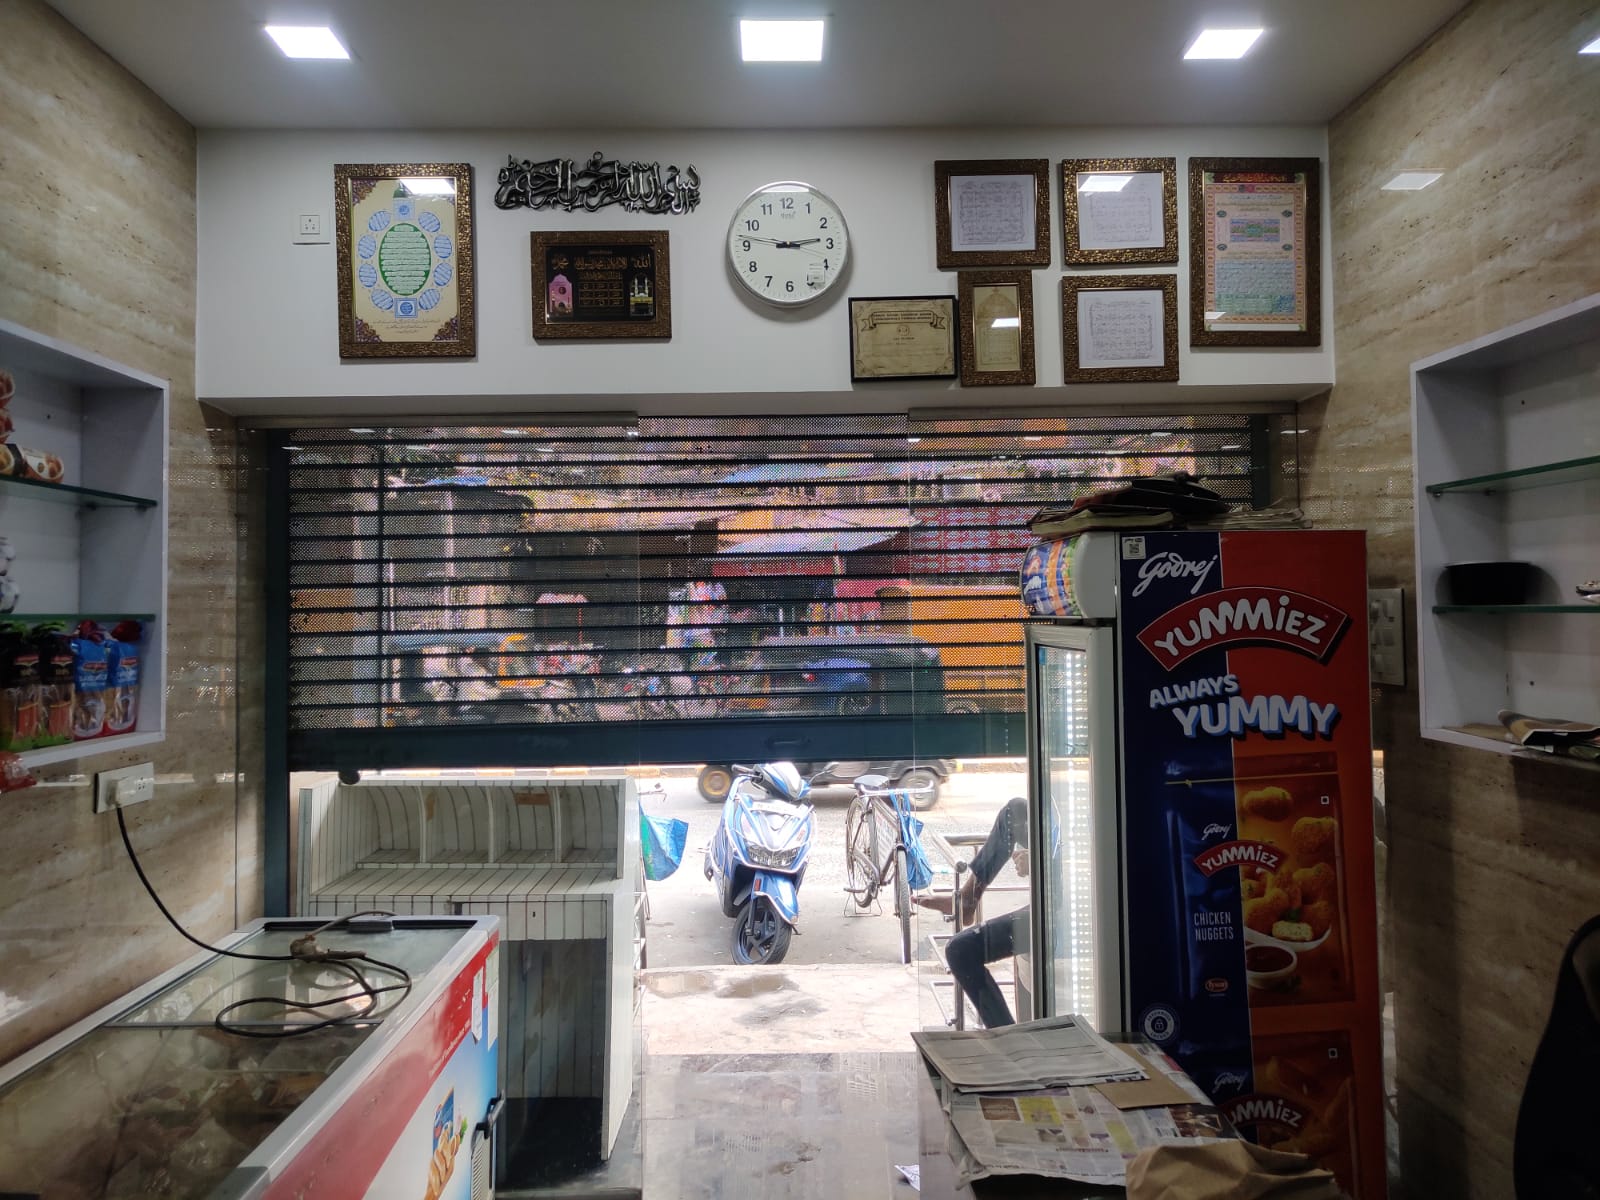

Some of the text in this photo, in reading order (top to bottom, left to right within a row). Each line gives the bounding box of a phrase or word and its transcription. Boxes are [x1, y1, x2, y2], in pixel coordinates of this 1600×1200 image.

[761, 203, 773, 215] 11
[779, 197, 794, 209] 12
[805, 203, 811, 214] 1
[745, 219, 760, 231] 10
[819, 217, 828, 229] 2
[742, 240, 751, 251] 9
[826, 238, 834, 249] 3
[749, 261, 757, 272] 8
[764, 276, 773, 287] 7
[785, 281, 794, 292] 6
[1131, 551, 1218, 597] Godrej
[1149, 674, 1239, 709] ALWAYS
[1173, 694, 1337, 737] YUMMY
[1194, 911, 1232, 926] CHICKEN
[1195, 925, 1234, 941] NUGGETS
